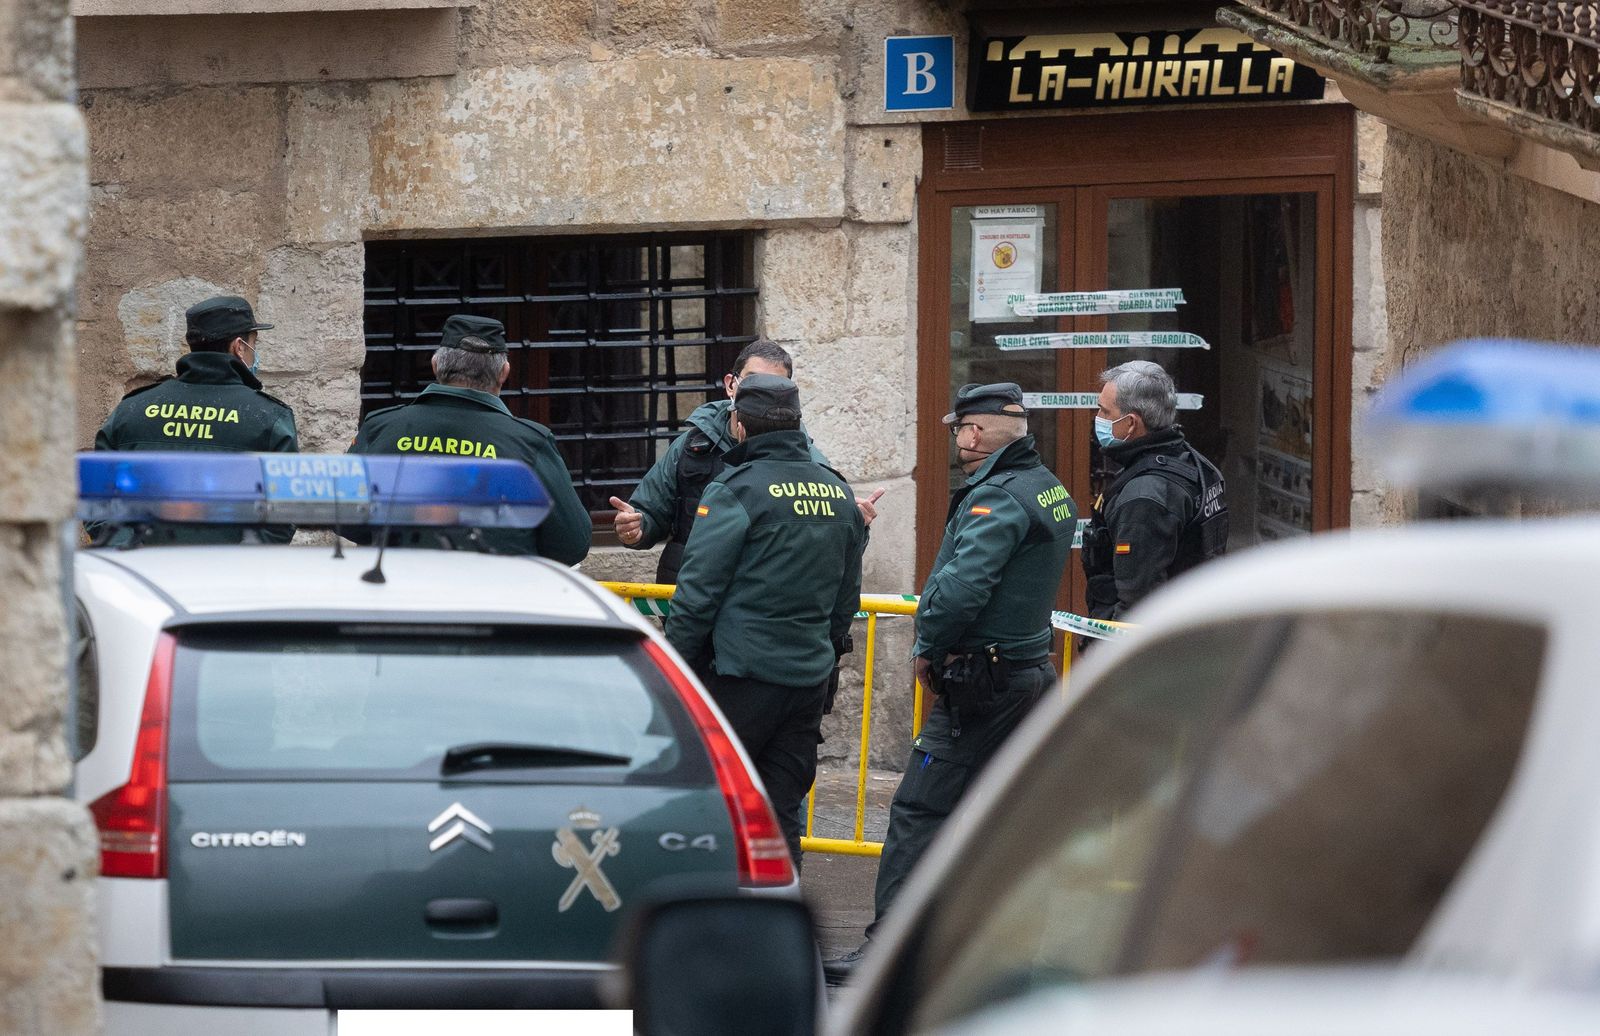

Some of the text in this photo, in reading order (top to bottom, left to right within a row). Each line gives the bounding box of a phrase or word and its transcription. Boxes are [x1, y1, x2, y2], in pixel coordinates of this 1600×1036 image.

[902, 52, 937, 95] B
[1008, 57, 1295, 103] LA-MURALLA
[1037, 302, 1074, 313] GUARDIA
[1076, 301, 1098, 312] CIVIL
[1118, 300, 1153, 311] GUARDIA
[1029, 336, 1050, 346] CIVIL
[1072, 334, 1108, 345] GUARDIA
[1110, 334, 1130, 344] CIVIL
[1152, 334, 1187, 345] GUARDIA
[1041, 395, 1078, 406] GUARDIA
[145, 404, 240, 424] GUARDIA
[162, 422, 214, 439] CIVIL
[396, 436, 497, 460] GUARDIA
[265, 459, 365, 481] GUARDIA
[768, 482, 847, 500] GUARDIA
[793, 500, 835, 517] CIVIL
[1053, 503, 1072, 523] CIVIL
[1204, 498, 1221, 518] CIVIL
[190, 829, 306, 848] CITROËN
[658, 832, 718, 852] C4
